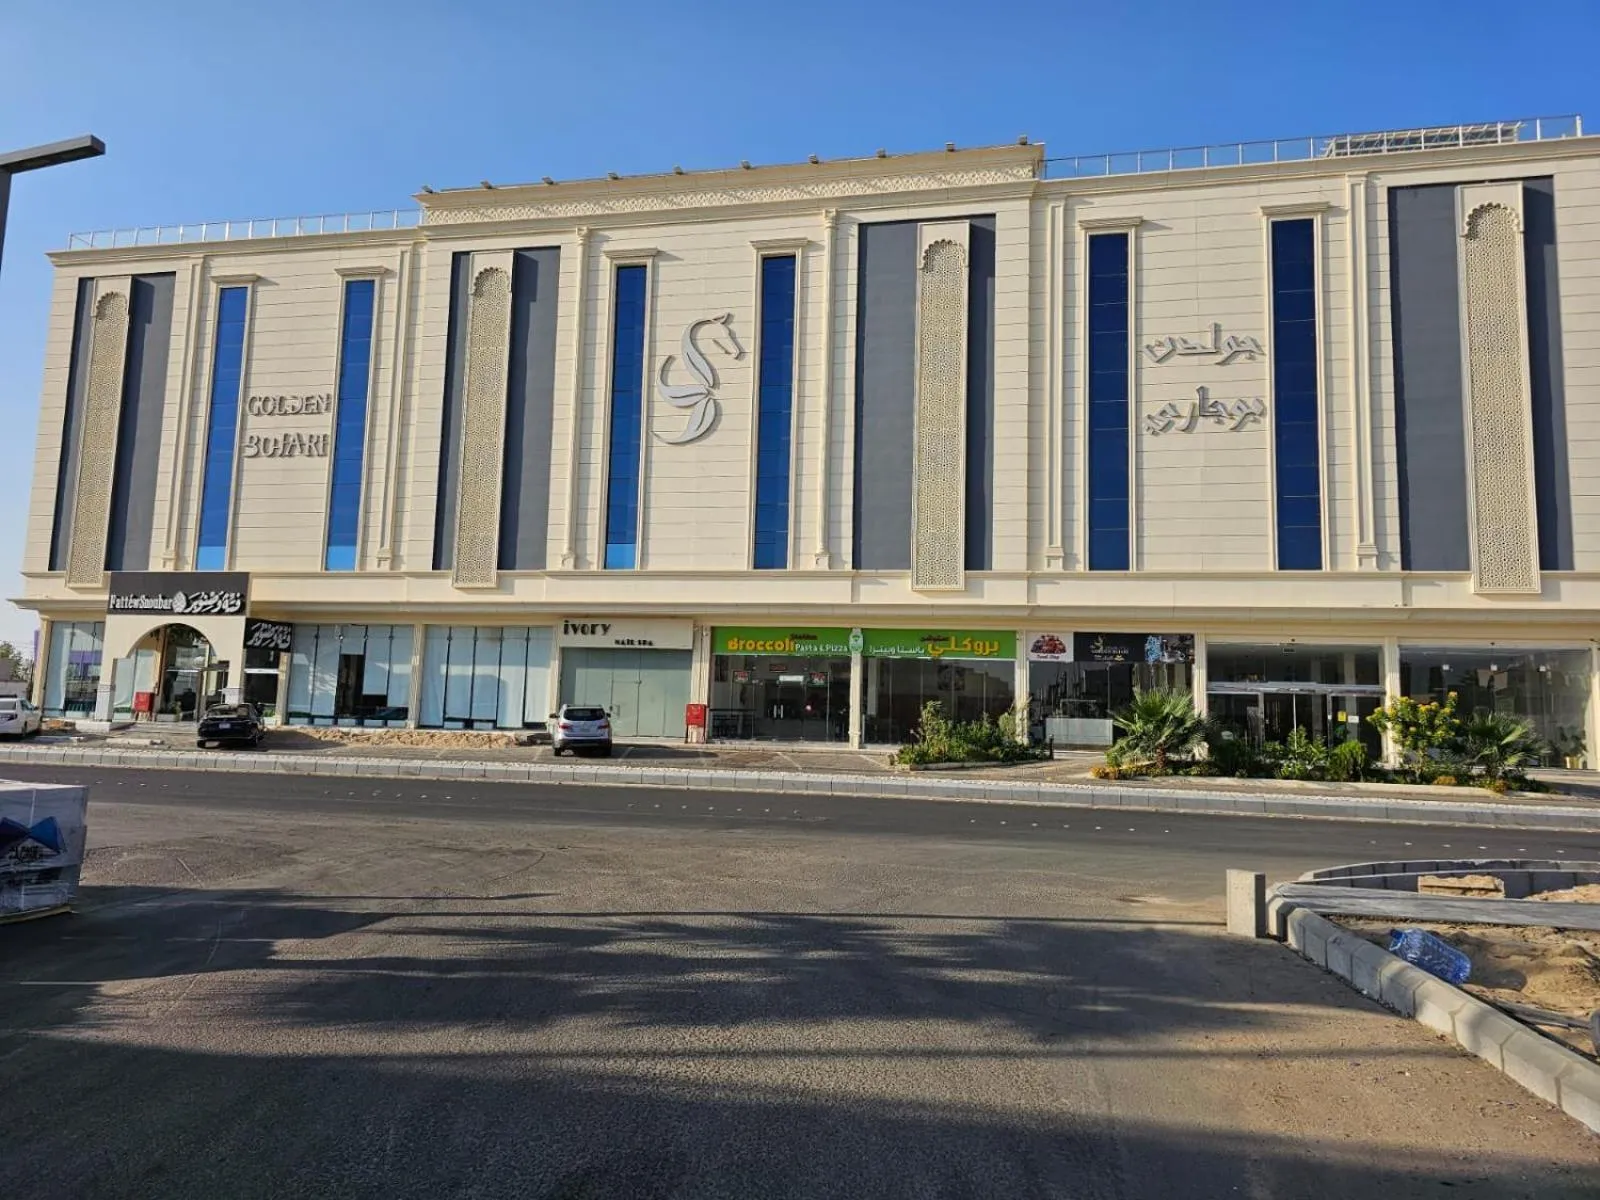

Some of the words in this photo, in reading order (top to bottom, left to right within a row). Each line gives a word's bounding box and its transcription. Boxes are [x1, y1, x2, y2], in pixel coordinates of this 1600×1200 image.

[1143, 322, 1267, 366] جولدن
[248, 393, 331, 416] GOLDEN
[1143, 386, 1267, 436] بوجاري
[563, 620, 611, 635] ivory
[927, 635, 1000, 657] بروكلي
